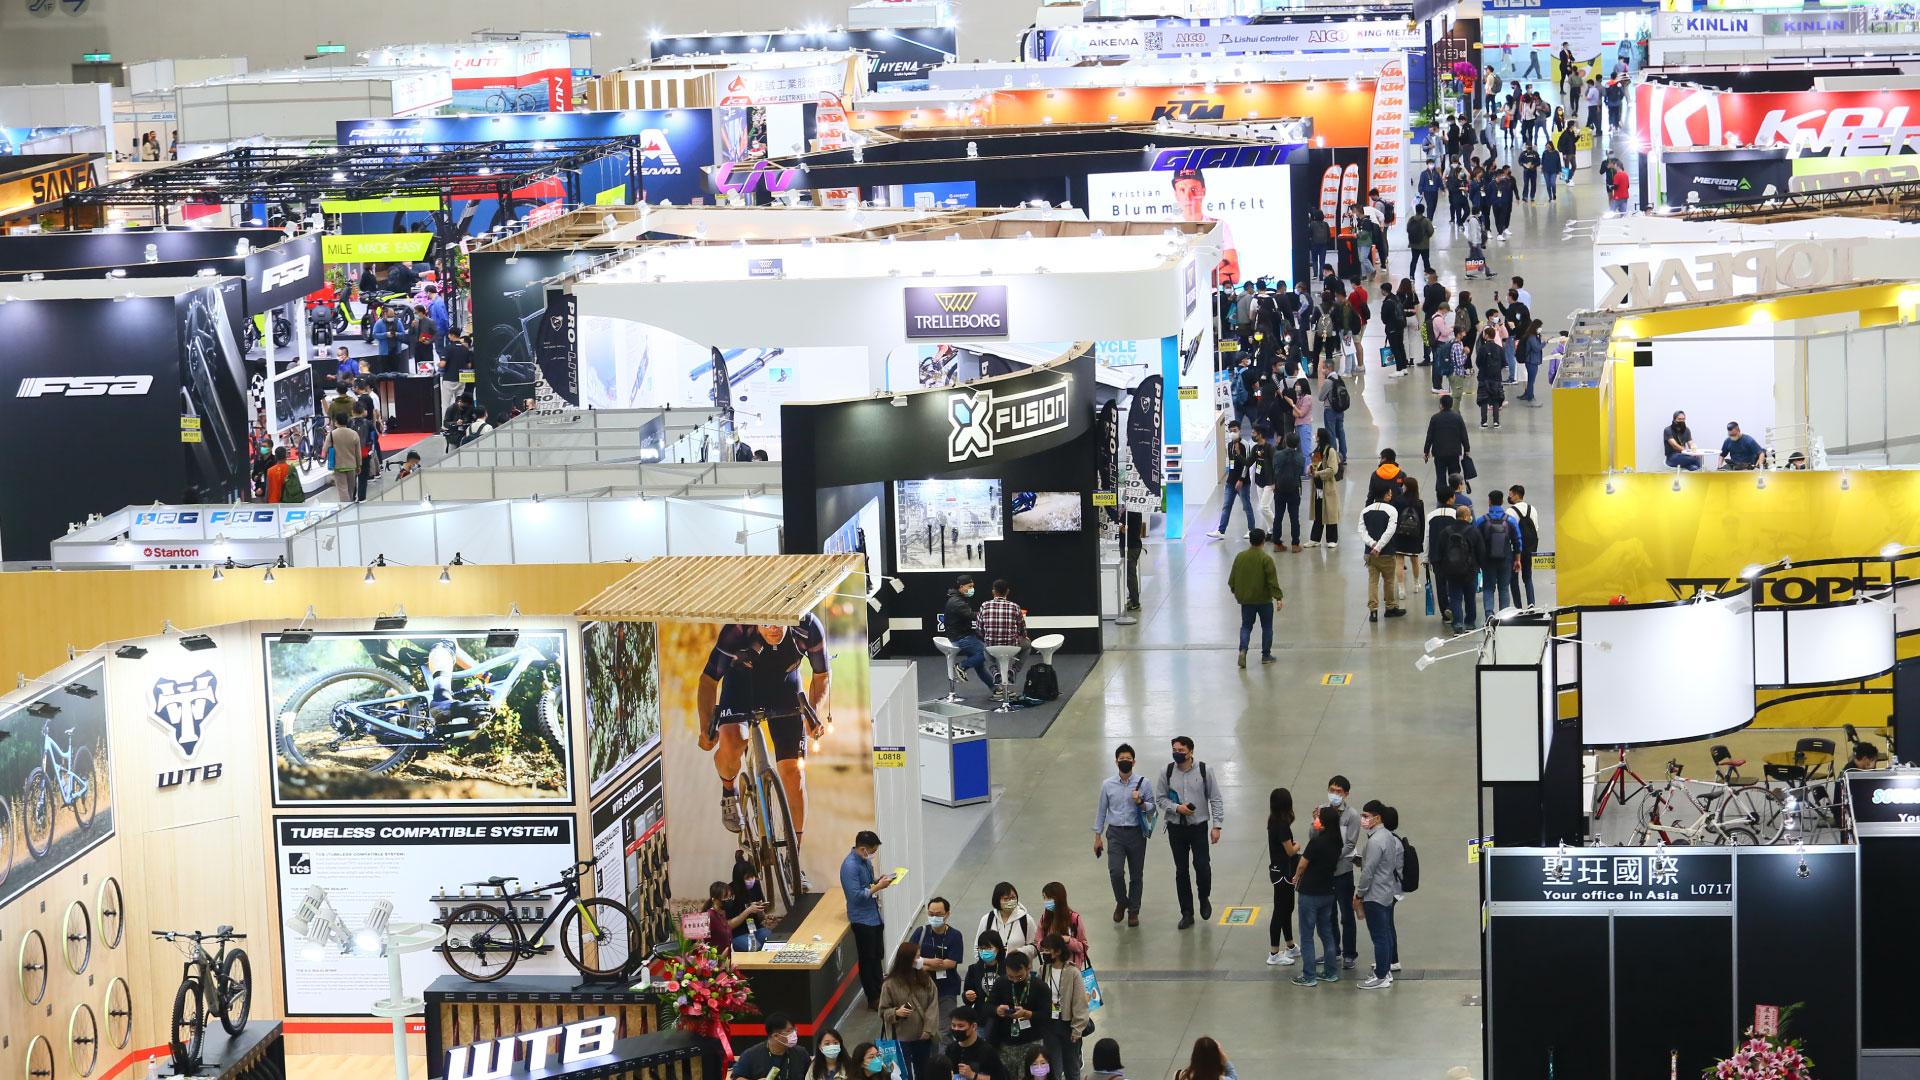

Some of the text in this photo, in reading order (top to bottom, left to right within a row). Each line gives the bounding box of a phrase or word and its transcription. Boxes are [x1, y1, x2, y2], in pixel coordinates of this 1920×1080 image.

[1687, 17, 1748, 32] KINLIN
[1783, 19, 1845, 32] KINLIN
[1176, 33, 1206, 42] AICO
[1234, 34, 1299, 43] Lishui Controller
[1308, 30, 1349, 43] AICO
[1357, 28, 1421, 37] KING-METER
[1089, 37, 1139, 47] AIKEMA
[879, 61, 918, 73] HYENA
[1151, 100, 1225, 120] KTM
[1376, 112, 1401, 120] KTM
[1375, 127, 1400, 135] KTM
[1374, 141, 1400, 150] KTM
[1151, 143, 1298, 171] GIANT
[1374, 156, 1398, 165] KTM
[1373, 170, 1397, 179] KTM
[31, 162, 99, 204] SANFA
[1693, 176, 1739, 186] MERIDA
[1112, 190, 1161, 199] Kristian
[328, 240, 424, 256] MILE MADE EASY
[261, 254, 310, 294] FSA
[914, 314, 1000, 329] TRELLEBORG
[16, 375, 154, 398] FSA
[948, 389, 1066, 463] X FUSION
[1151, 382, 1162, 485] PRO-LITE
[153, 547, 199, 558] Stanton
[1736, 577, 1908, 604] TOPE
[878, 753, 902, 761] L0818
[156, 763, 223, 788] WTB
[612, 780, 643, 815] WTB SADDLES
[290, 825, 559, 839] TUBELESS COMPATIBLE SYSTEM
[291, 866, 310, 874] TCS
[1543, 889, 1679, 901] Your office in Asia
[1690, 884, 1731, 895] L0717
[443, 1015, 618, 1080] WTB
